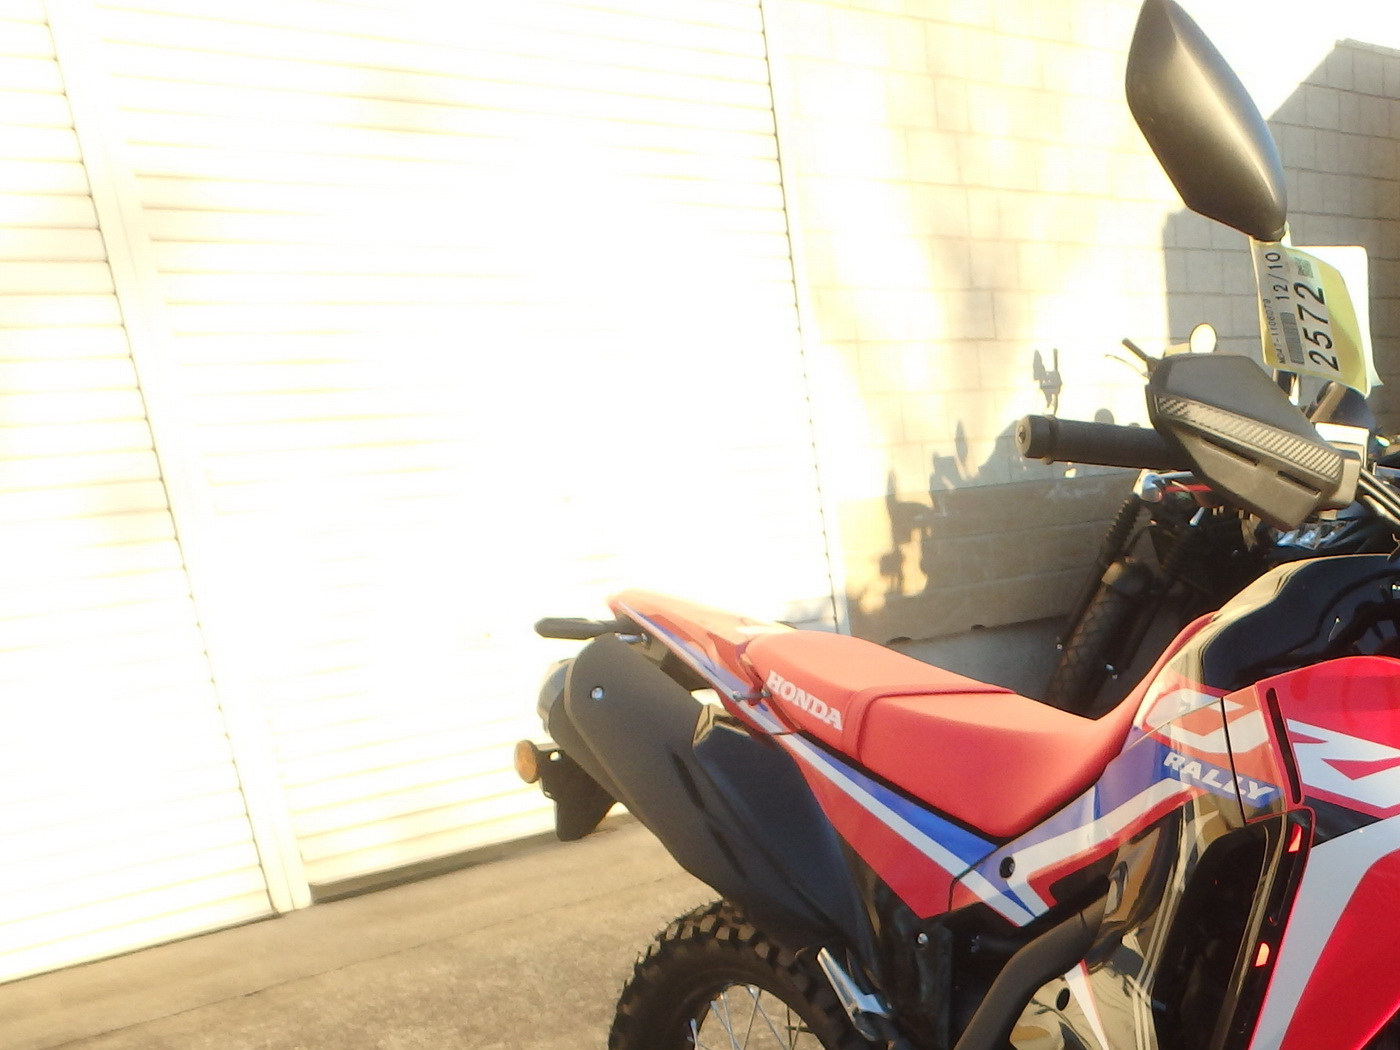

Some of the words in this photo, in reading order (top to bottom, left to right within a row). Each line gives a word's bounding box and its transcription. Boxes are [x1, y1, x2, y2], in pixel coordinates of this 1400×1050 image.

[1264, 252, 1291, 301] 12/10
[1293, 282, 1341, 373] 2572
[765, 668, 844, 732] HONDA
[1162, 751, 1276, 801] RALLY
